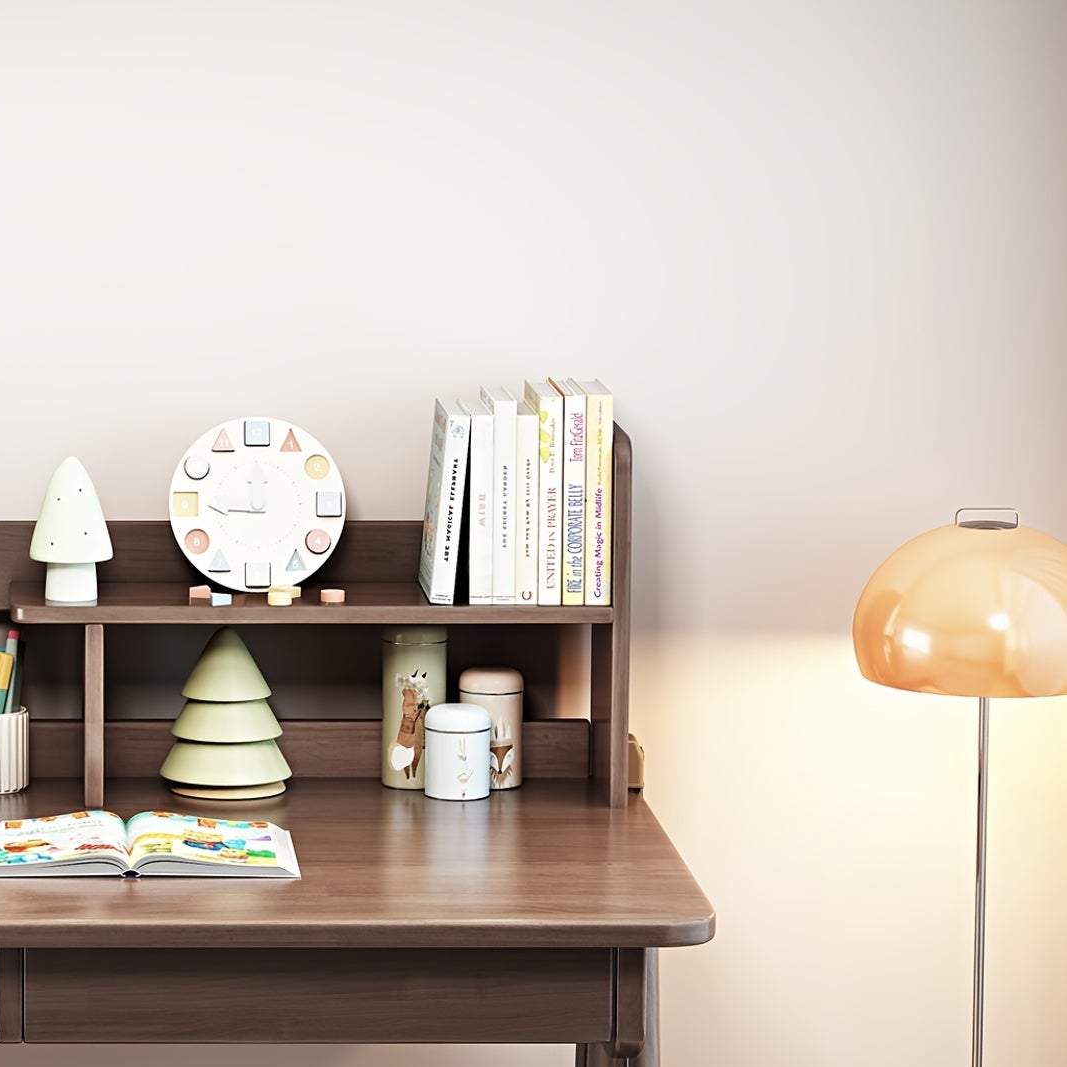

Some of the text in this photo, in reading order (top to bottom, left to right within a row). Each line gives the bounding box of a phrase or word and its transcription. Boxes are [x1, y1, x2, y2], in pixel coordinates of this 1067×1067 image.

[314, 463, 321, 472] 2
[570, 448, 583, 463] Tom
[545, 487, 557, 589] UNITED IN PRAYER
[567, 484, 583, 593] FIRE in the CORPORATE BELLY
[593, 488, 604, 598] Creating Magic in Midlife
